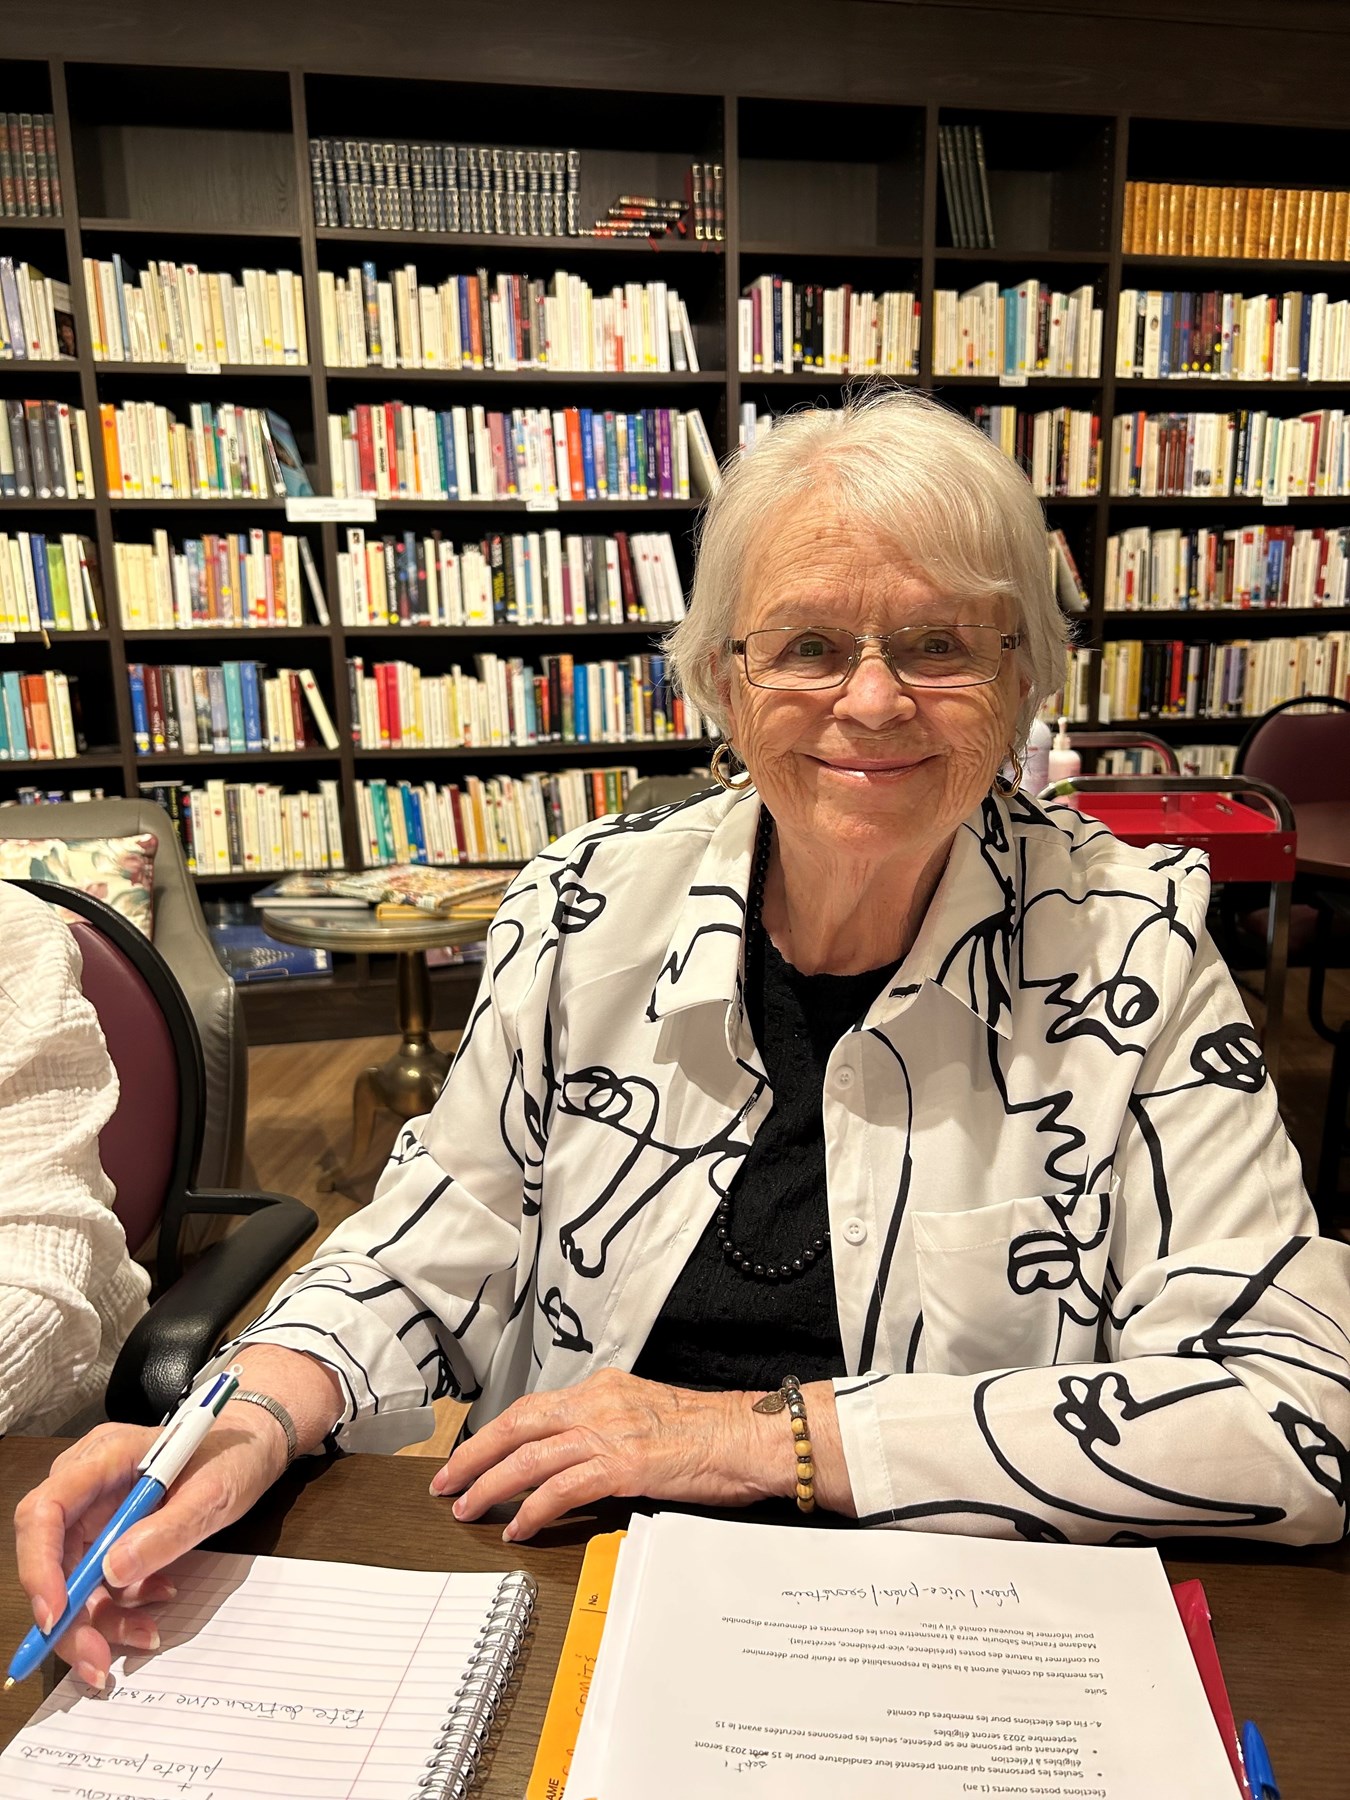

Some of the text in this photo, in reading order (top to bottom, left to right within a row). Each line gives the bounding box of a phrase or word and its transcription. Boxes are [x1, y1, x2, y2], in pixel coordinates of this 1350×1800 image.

[722, 1617, 762, 1626] disponible
[764, 1621, 808, 1631] demeurera
[820, 1626, 864, 1635] documents
[899, 1631, 948, 1640] transmettre
[982, 1637, 1019, 1646] Sabourin
[1021, 1640, 1057, 1648] Francine
[742, 1648, 788, 1659] déterminer
[1005, 1653, 1033, 1661] nature
[811, 1655, 836, 1663] réunir
[862, 1658, 920, 1667] responsabilité
[1001, 1668, 1031, 1676] comité
[176, 1694, 277, 1719] Francine
[279, 1704, 303, 1720] de
[919, 1711, 930, 1719] du
[932, 1712, 974, 1720] membres
[976, 1715, 989, 1723] les
[1013, 1718, 1054, 1727] élections
[738, 1724, 762, 1732] avant
[1055, 1720, 1072, 1728] des
[764, 1727, 805, 1736] recrutées
[808, 1731, 853, 1740] personnes
[933, 1729, 1077, 1743] septembre 2023 seront éligibles
[855, 1735, 868, 1743] les
[870, 1736, 898, 1744] seules
[695, 1741, 723, 1750] seront
[725, 1745, 747, 1755] 2023
[970, 1743, 1013, 1751] personne
[771, 1751, 782, 1759] 15
[1034, 1746, 1079, 1755] Advenant
[785, 1752, 793, 1760] le
[818, 1755, 873, 1765] candidature
[875, 1760, 893, 1768] leur
[895, 1761, 935, 1770] présenté
[1035, 1758, 1041, 1766] à
[1043, 1758, 1082, 1767] éligibles
[152, 1757, 223, 1782] photo
[970, 1765, 986, 1773] qui
[987, 1767, 1036, 1775] personnes
[1037, 1769, 1052, 1777] les
[1053, 1770, 1084, 1778] Seules
[963, 1783, 978, 1792] an)
[980, 1784, 990, 1793] (1
[1030, 1787, 1061, 1795] postes
[1063, 1788, 1106, 1799] Élections
